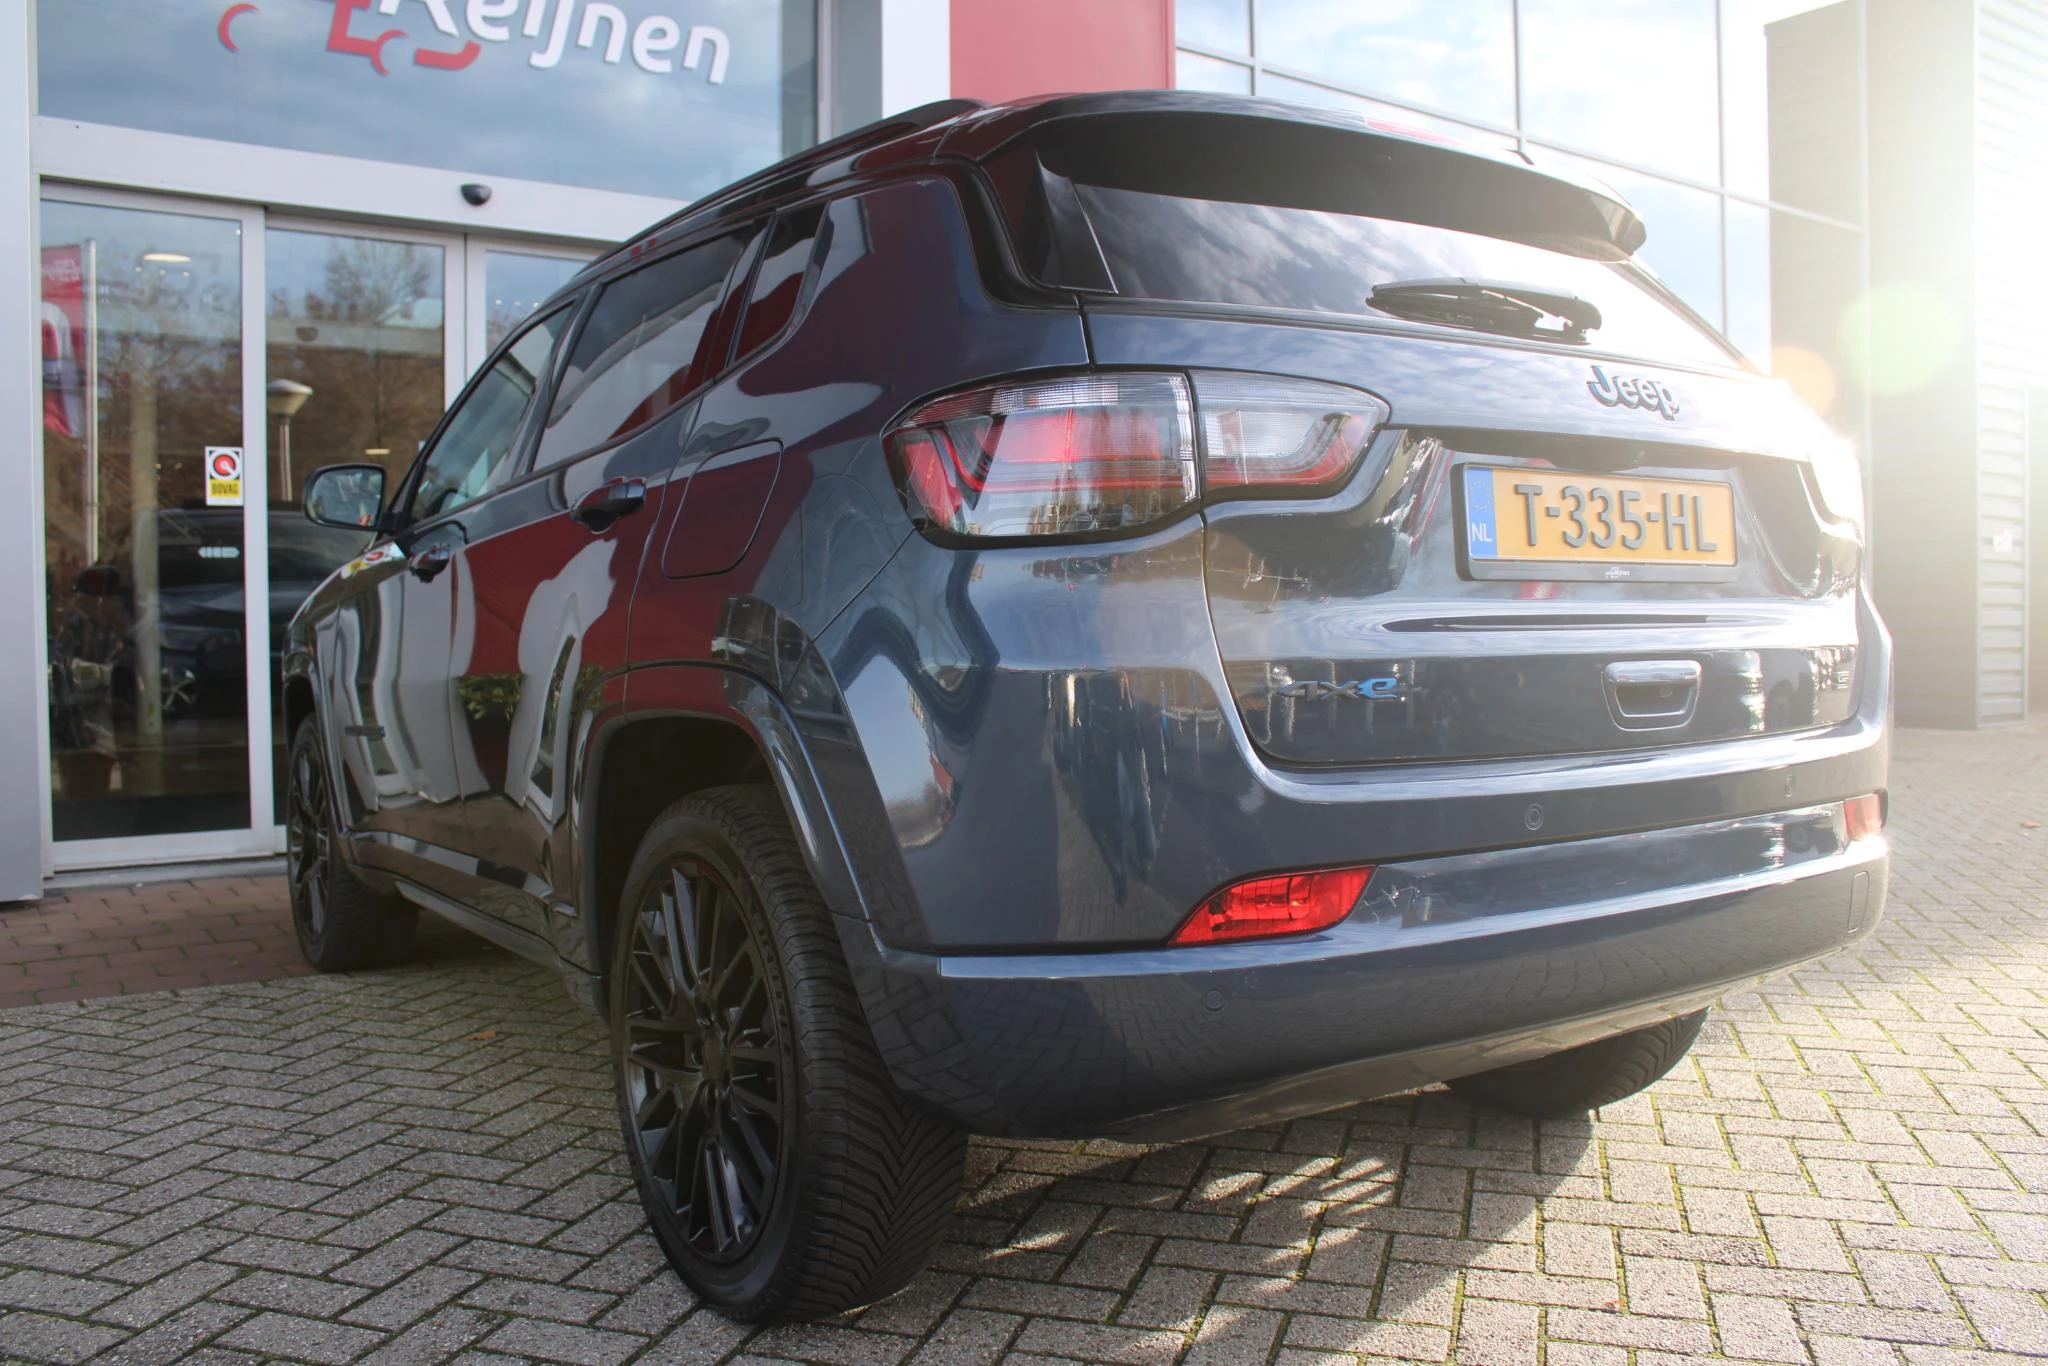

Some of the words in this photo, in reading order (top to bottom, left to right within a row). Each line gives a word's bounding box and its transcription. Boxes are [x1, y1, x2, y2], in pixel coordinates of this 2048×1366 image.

[1586, 365, 1680, 421] Jeep
[1471, 523, 1493, 542] NL
[1514, 483, 1718, 552] T-335-HL
[1279, 677, 1398, 700] 4xe
